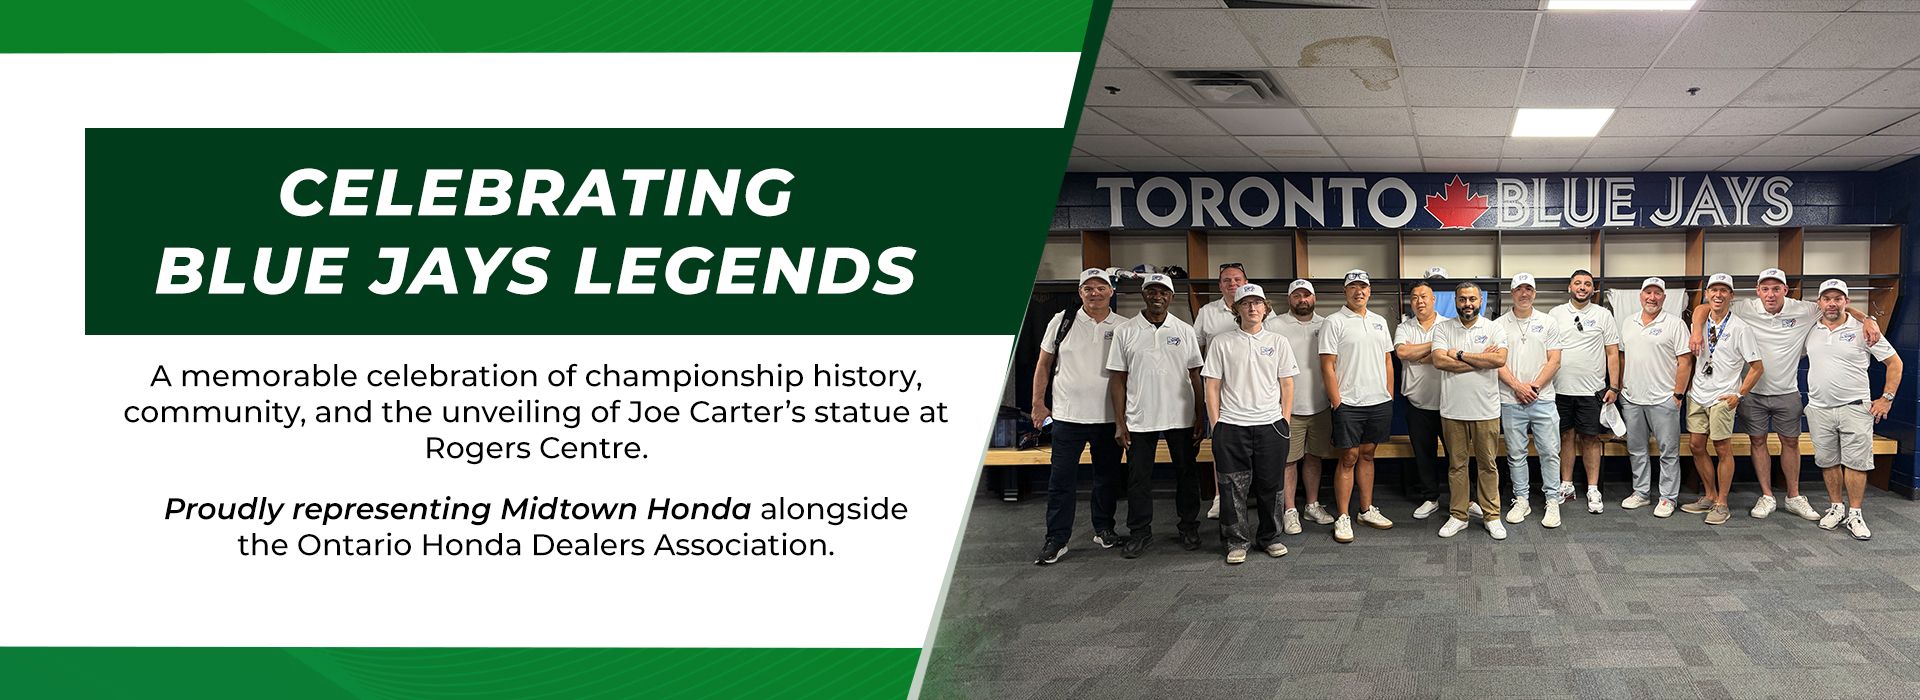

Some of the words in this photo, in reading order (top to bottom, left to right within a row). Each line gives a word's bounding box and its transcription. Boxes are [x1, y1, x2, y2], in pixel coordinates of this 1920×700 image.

[1096, 176, 1417, 228] TORONTO
[1495, 176, 1637, 228] BLUE
[1649, 174, 1794, 228] JAYS
